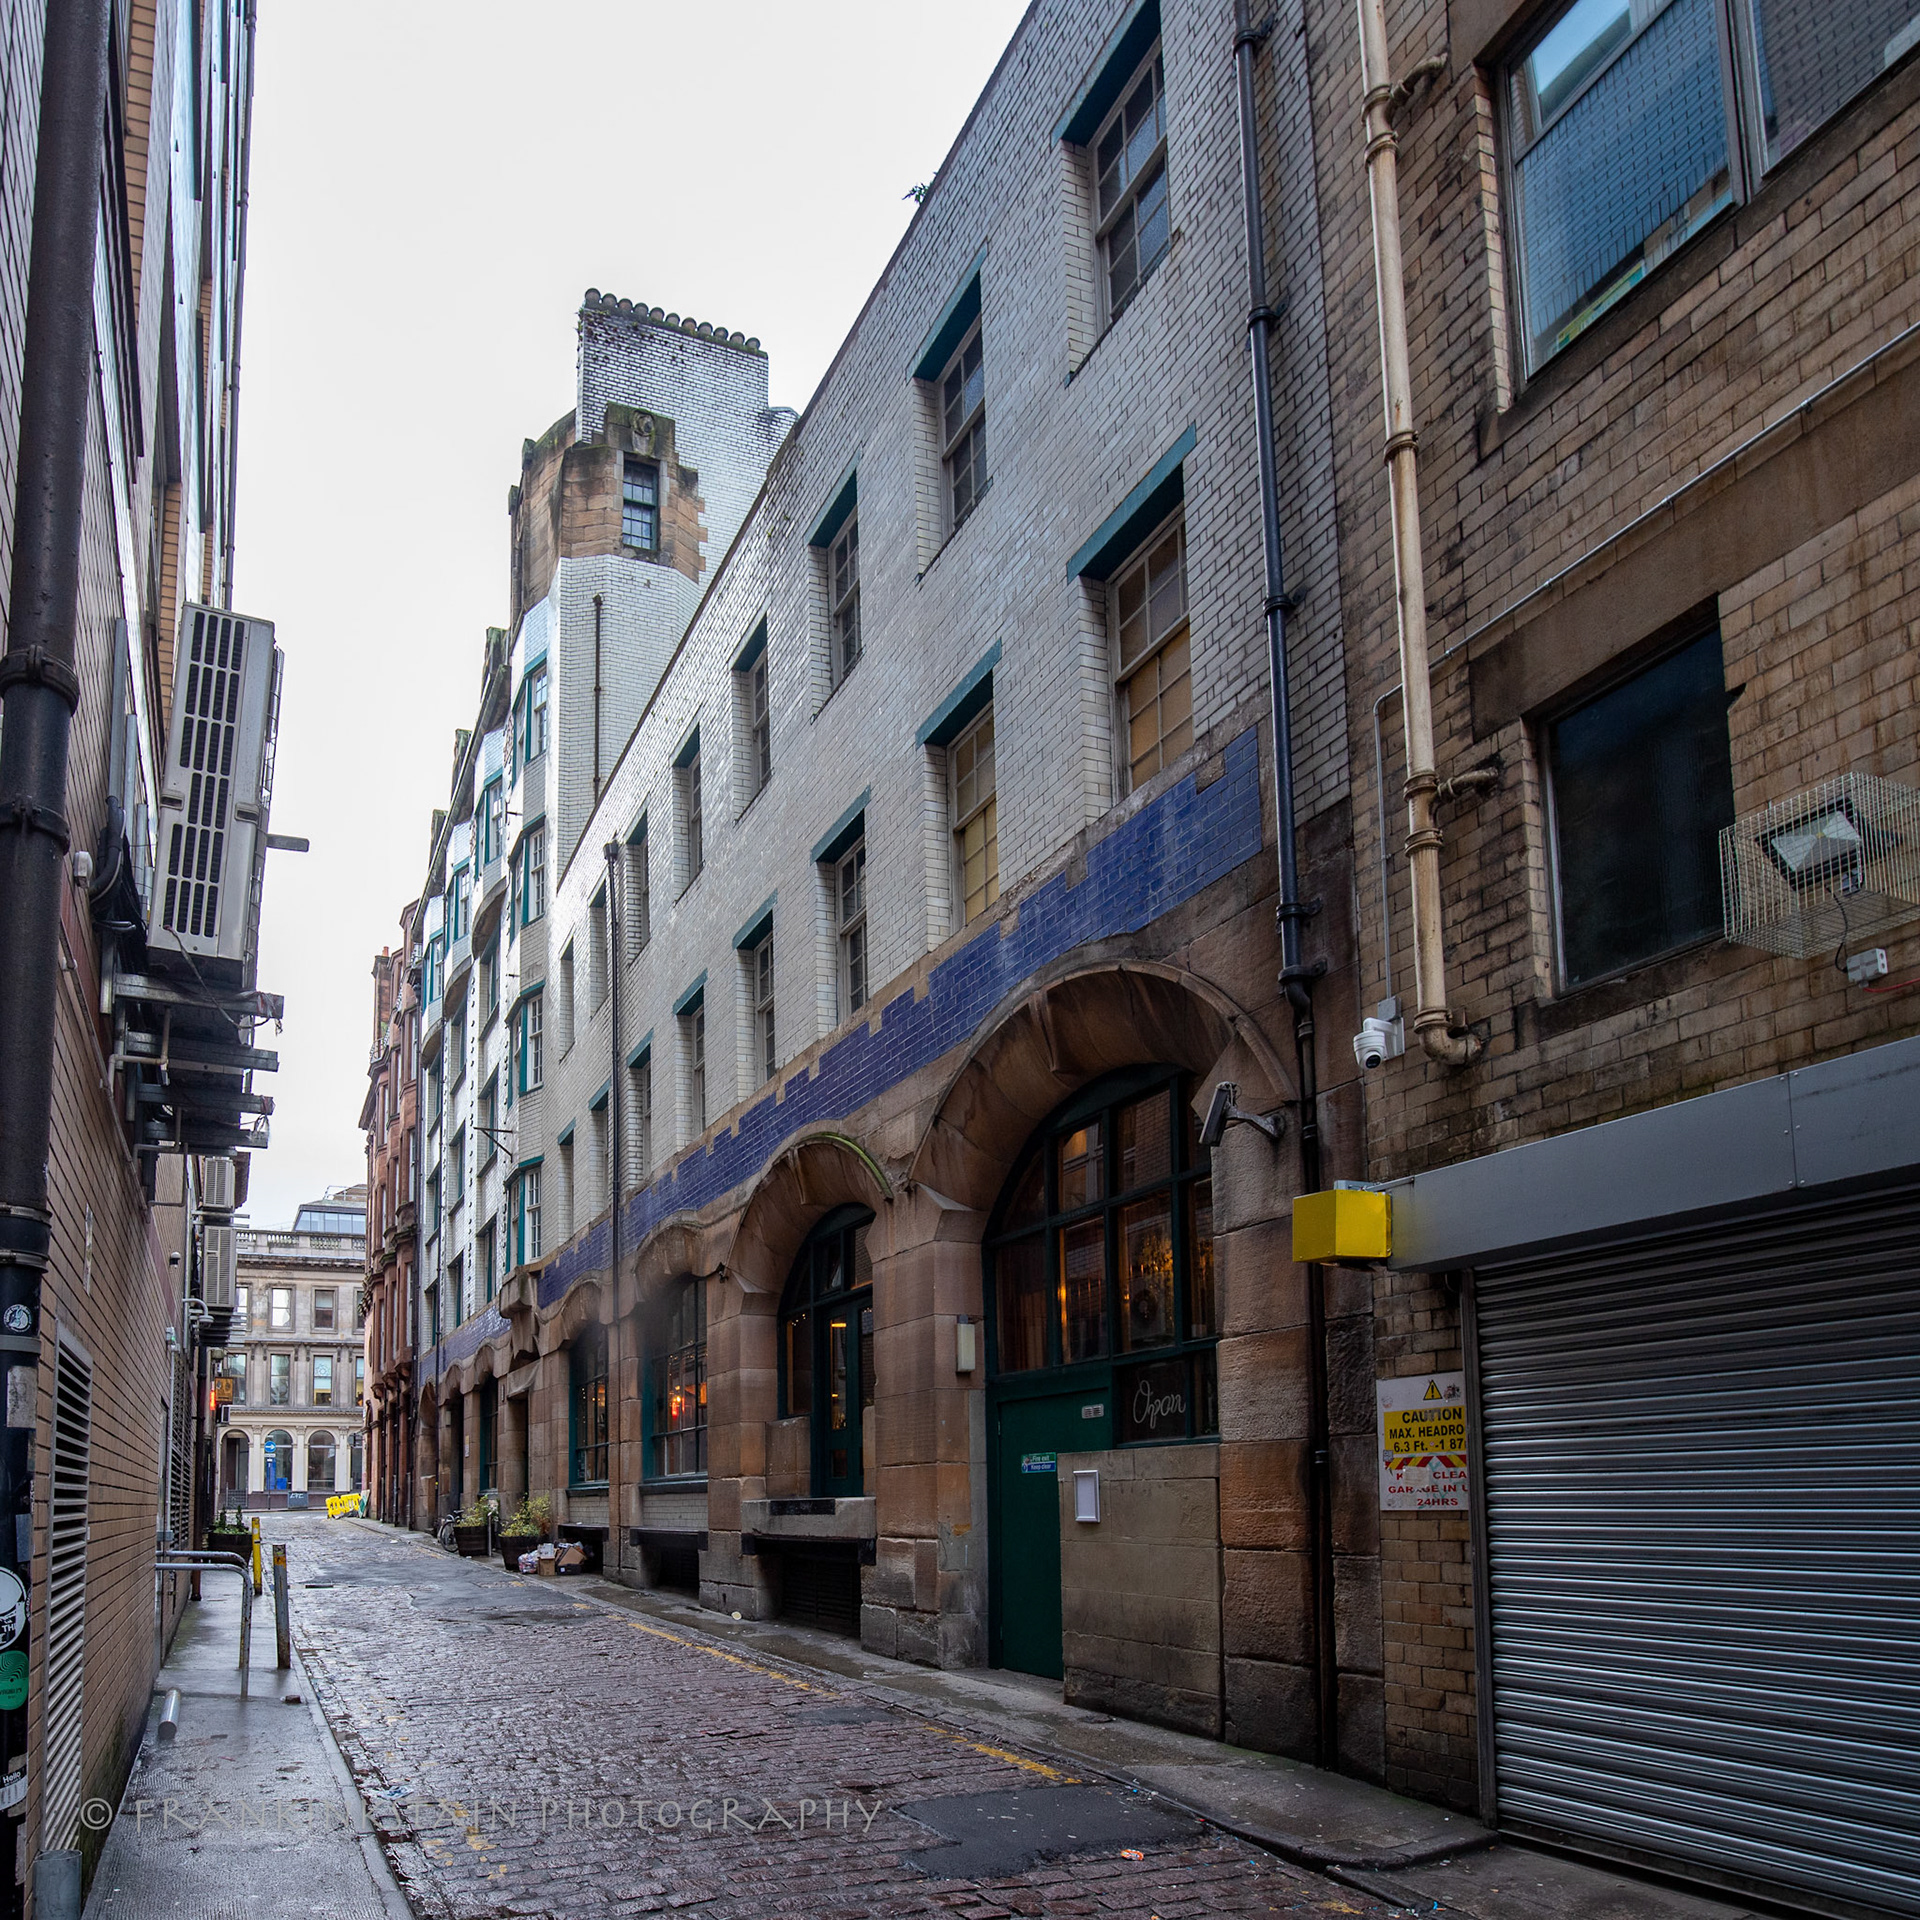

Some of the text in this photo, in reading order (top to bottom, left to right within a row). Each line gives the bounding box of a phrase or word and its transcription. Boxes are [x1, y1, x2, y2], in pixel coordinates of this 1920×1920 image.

[1133, 1379, 1187, 1430] Open
[1402, 1407, 1462, 1424] CAUTION
[1389, 1427, 1415, 1440] MAX.
[1393, 1441, 1410, 1453] 6.3
[1414, 1440, 1428, 1452] Ft.
[1443, 1484, 1457, 1493] IN
[1417, 1498, 1459, 1506] 24HRS
[2, 1771, 21, 1784] Hello
